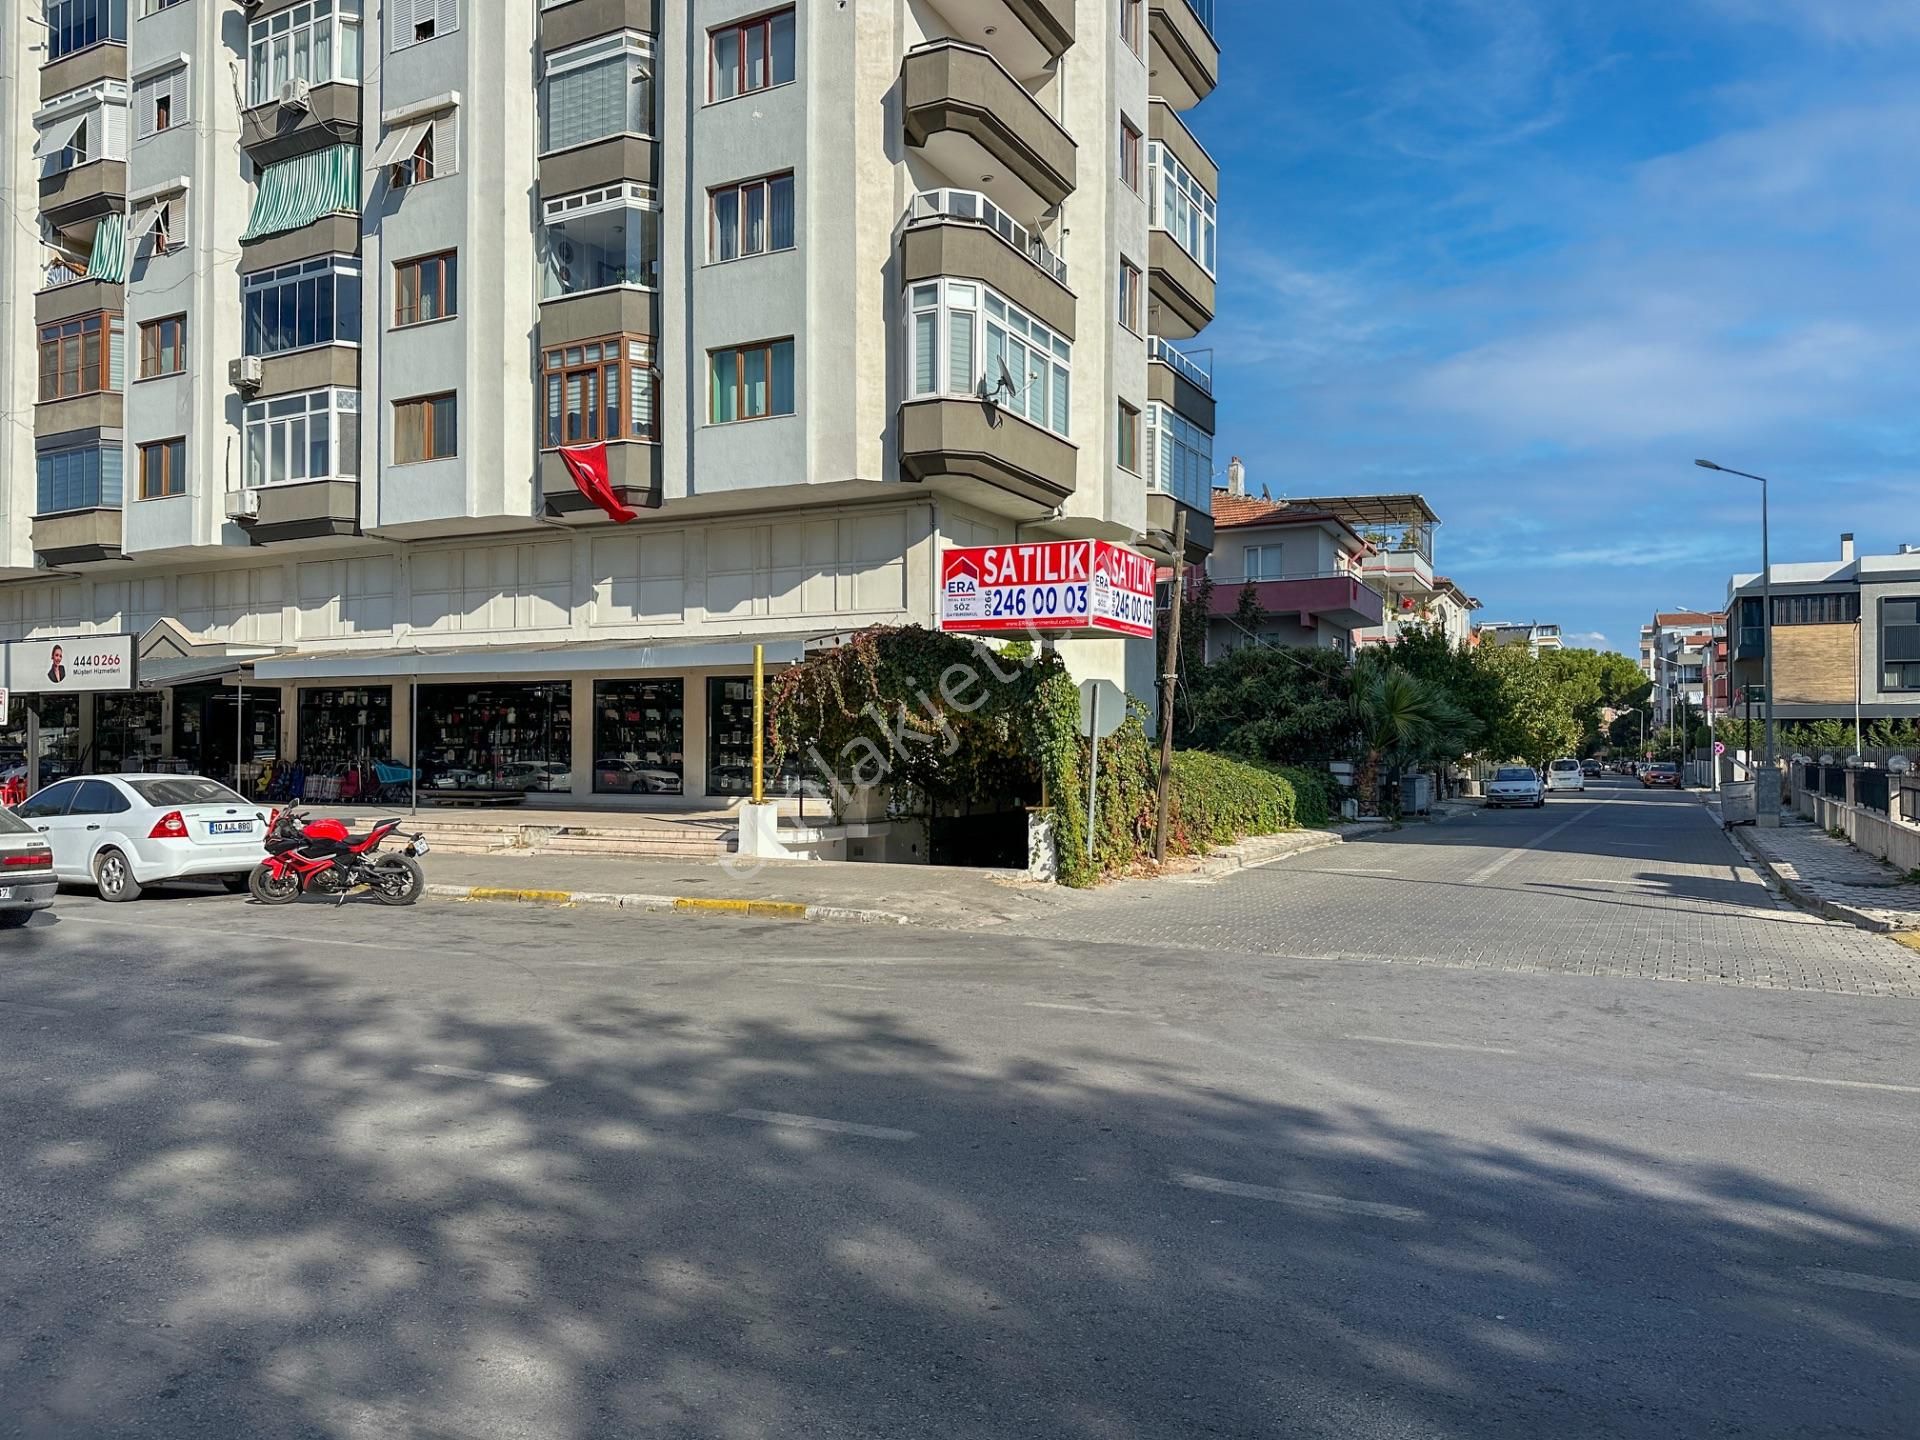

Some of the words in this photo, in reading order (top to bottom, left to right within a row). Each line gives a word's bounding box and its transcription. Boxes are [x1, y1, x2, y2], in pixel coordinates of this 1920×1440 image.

[983, 543, 1087, 585] SATILIK
[1111, 548, 1153, 595] SATILIK
[948, 581, 976, 593] ERA
[1095, 575, 1109, 590] ERA
[953, 602, 970, 611] SÖZ
[992, 588, 1026, 616] 246
[1032, 587, 1057, 614] 00
[1064, 585, 1088, 613] 03
[1115, 590, 1130, 620] 246
[1131, 595, 1142, 623] 00
[1143, 598, 1152, 625] 03
[73, 668, 92, 676] Müşteri
